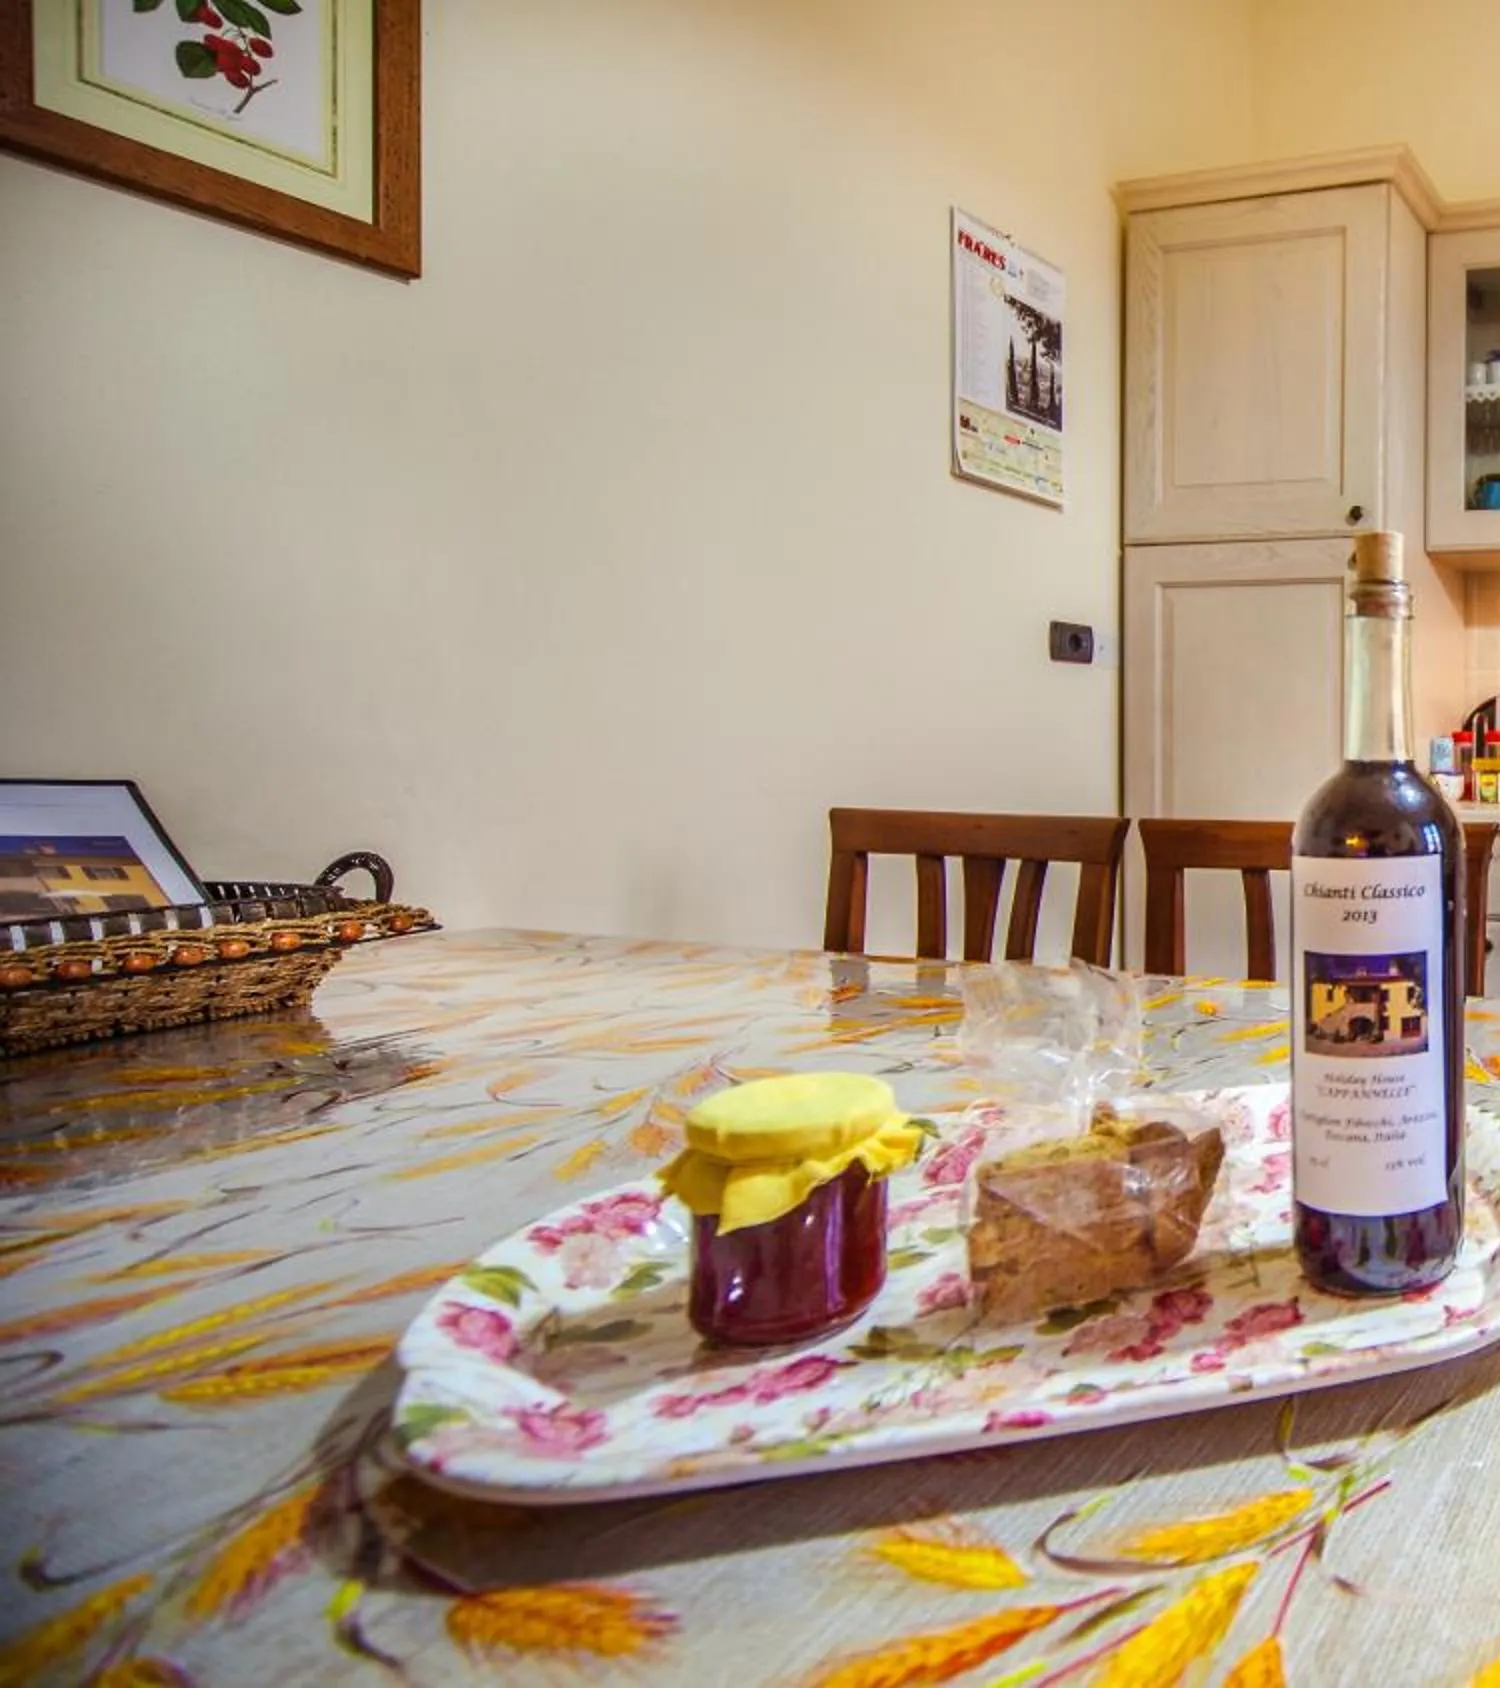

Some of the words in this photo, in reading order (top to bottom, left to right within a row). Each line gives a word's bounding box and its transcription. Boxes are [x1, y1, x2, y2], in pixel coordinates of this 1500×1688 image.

[1303, 882, 1356, 900] Chianti
[1361, 883, 1425, 900] Classico
[1342, 909, 1378, 924] 2013
